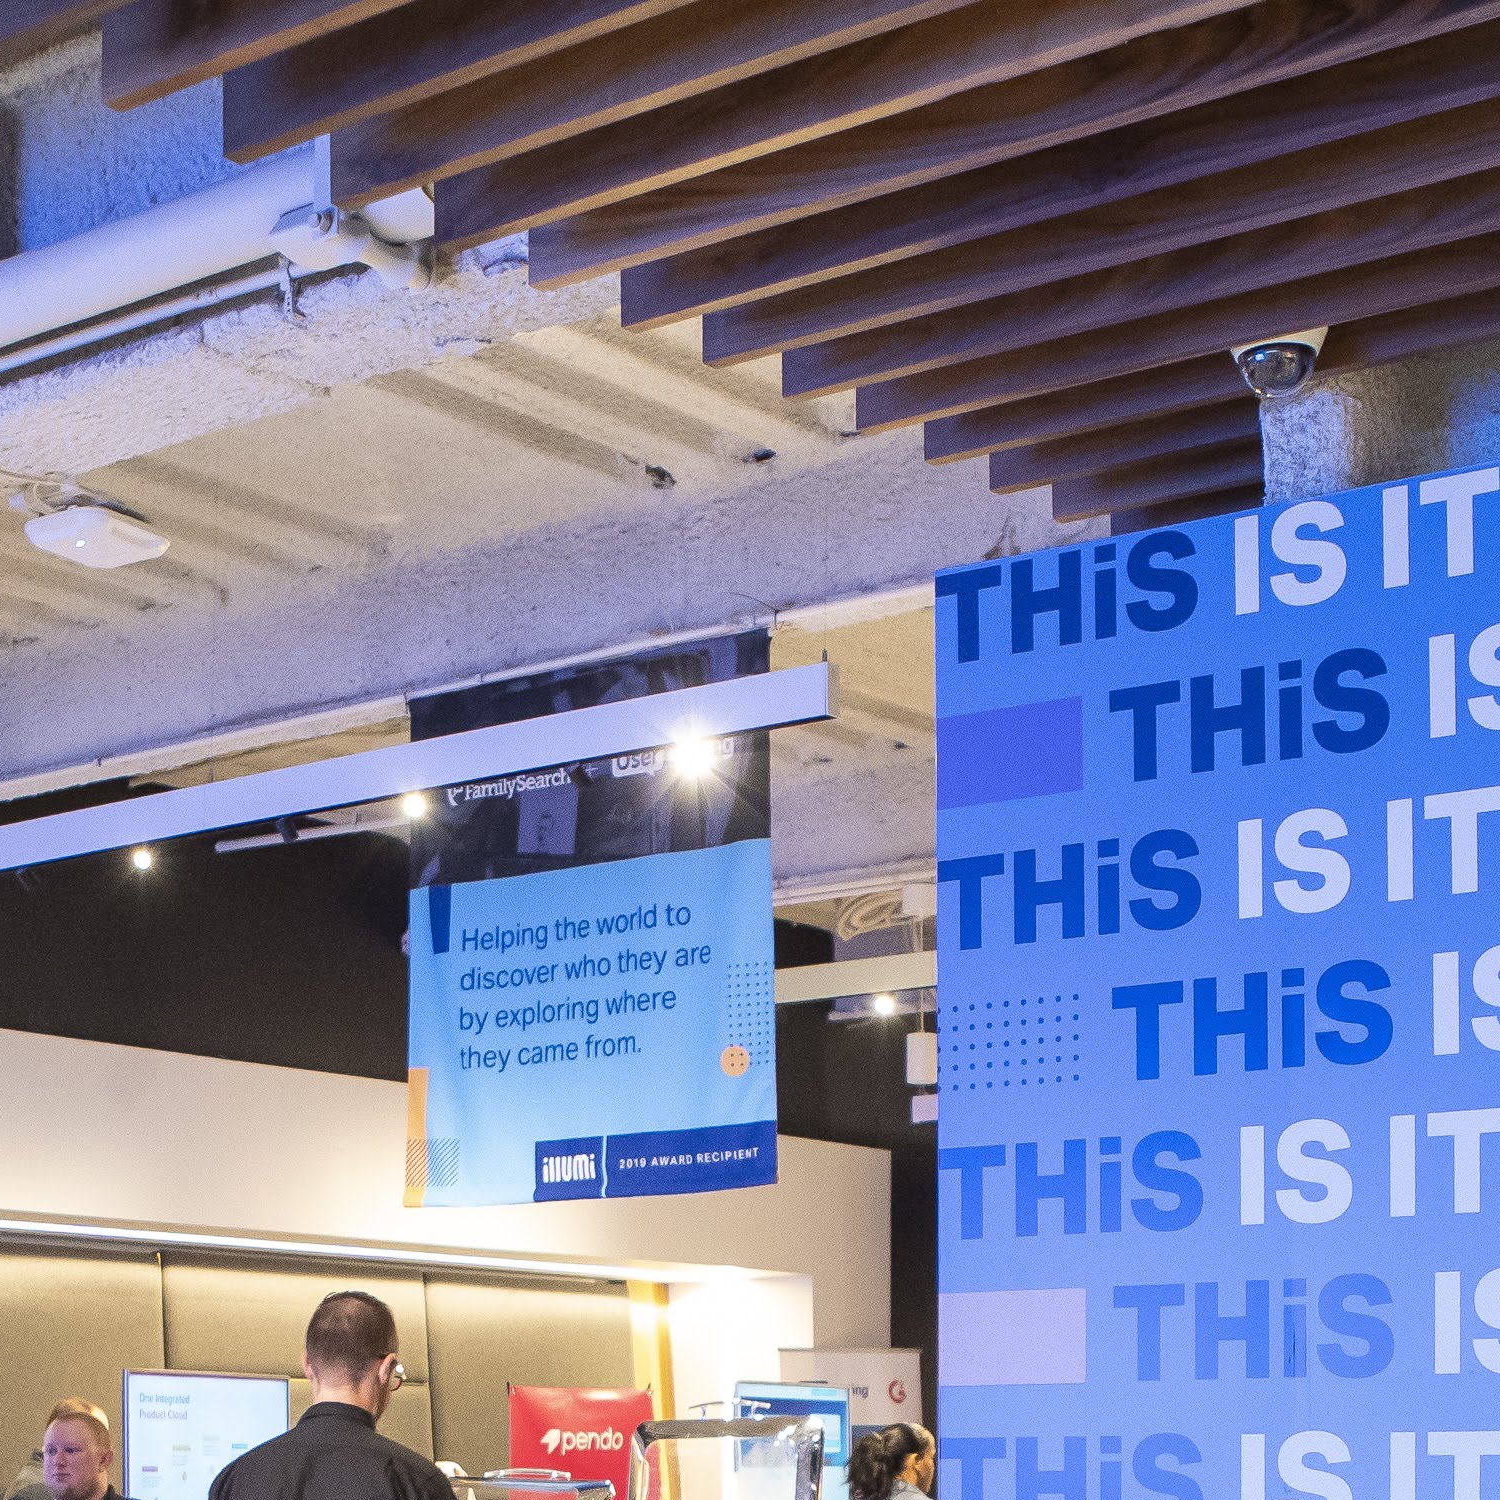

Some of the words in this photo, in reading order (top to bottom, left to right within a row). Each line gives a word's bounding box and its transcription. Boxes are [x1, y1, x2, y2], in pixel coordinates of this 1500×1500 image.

[935, 531, 1198, 664] THiS
[1234, 501, 1345, 616] IS
[1381, 467, 1500, 589] IT
[1109, 649, 1391, 782] THiS
[463, 769, 571, 800] FamilySearch
[937, 830, 1202, 950] THiS
[1237, 810, 1351, 919] IS
[461, 922, 549, 954] Helping
[555, 916, 590, 942] the
[596, 904, 657, 936] world
[665, 905, 691, 927] to
[460, 962, 558, 991] discover
[564, 953, 611, 980] who
[617, 945, 668, 976] they
[675, 944, 712, 967] are
[459, 1006, 489, 1035] by
[495, 997, 599, 1032] exploring
[605, 989, 677, 1015] where
[1112, 960, 1393, 1081] THiS
[460, 1045, 511, 1073] they
[517, 1041, 579, 1065] came
[585, 1034, 642, 1057] from.
[619, 1158, 647, 1169] 2019
[650, 1155, 693, 1167] AWARD
[696, 1147, 759, 1164] RECIPIENT
[938, 1131, 1203, 1239] THiS
[1240, 1119, 1352, 1225] IS
[1113, 1273, 1395, 1381] THiS
[139, 1408, 166, 1420] Product
[168, 1408, 188, 1420] Cloud
[155, 1393, 190, 1406] Integrated
[562, 1427, 624, 1456] pendo
